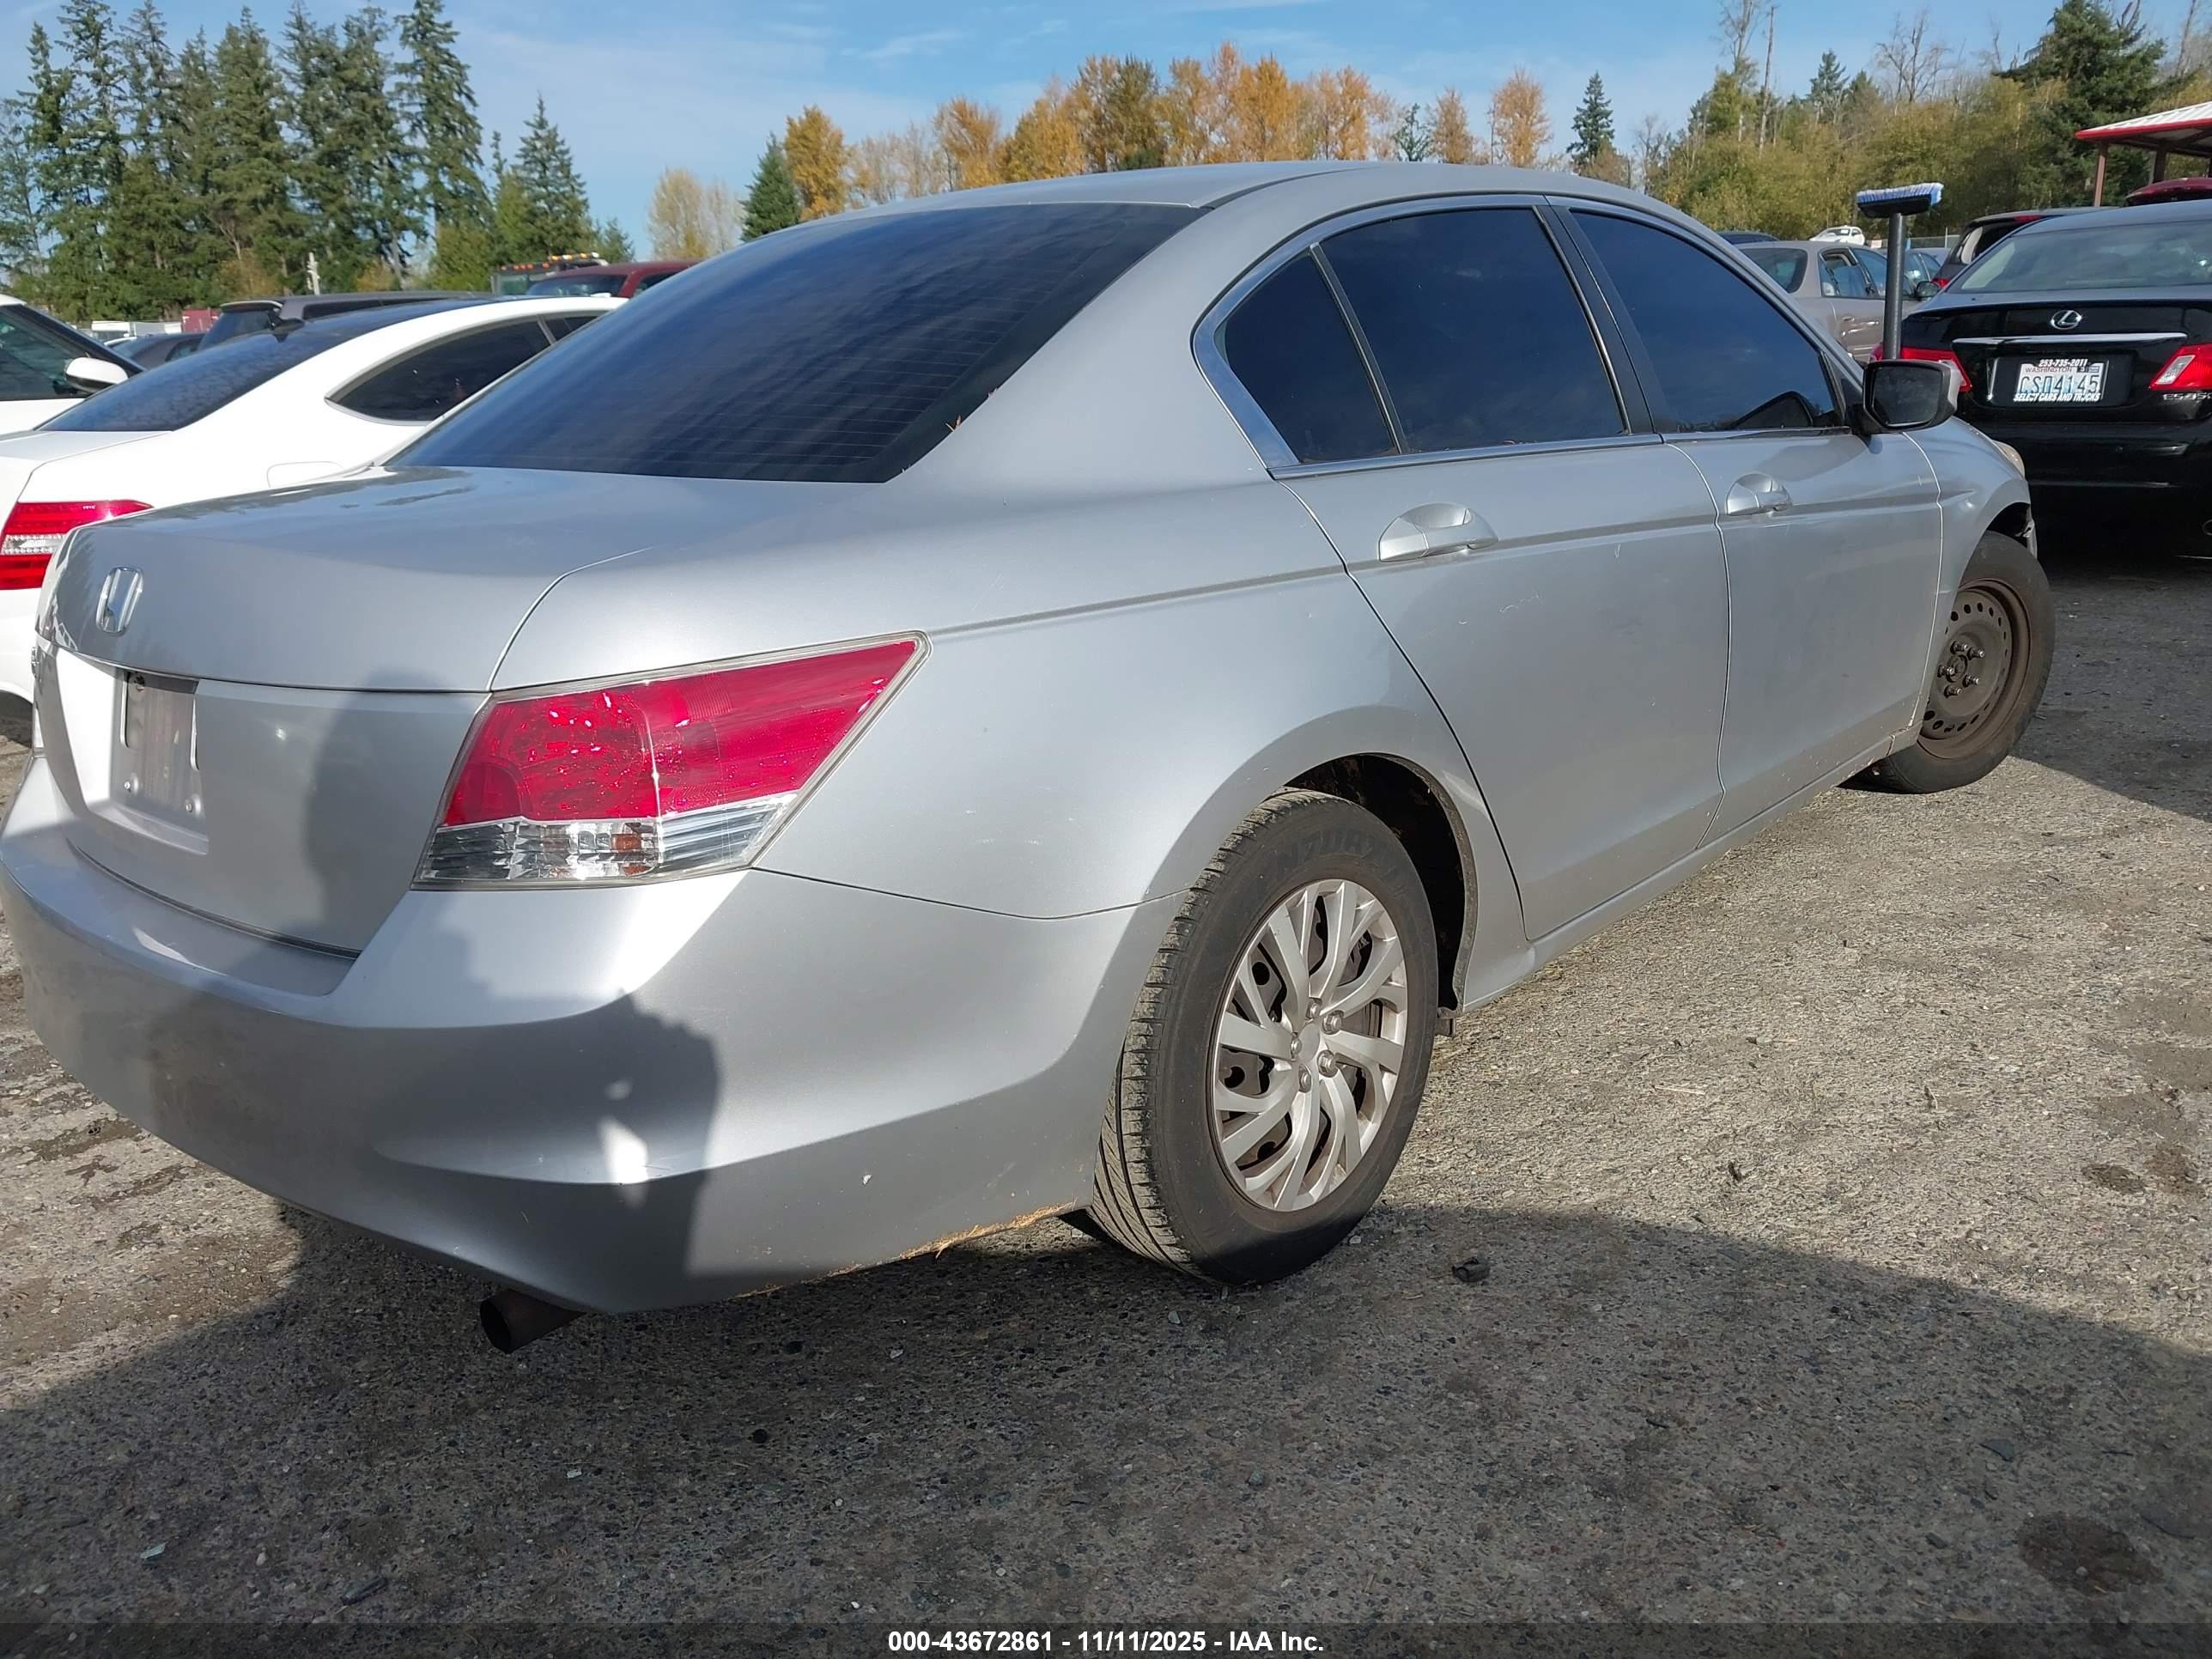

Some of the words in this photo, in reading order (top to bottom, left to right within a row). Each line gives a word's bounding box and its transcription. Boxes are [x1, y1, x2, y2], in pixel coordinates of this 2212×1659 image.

[2013, 392, 2038, 401] SELECT
[2038, 392, 2057, 401] CARS
[2056, 392, 2073, 401] AND
[2073, 391, 2100, 401] TRUCKS
